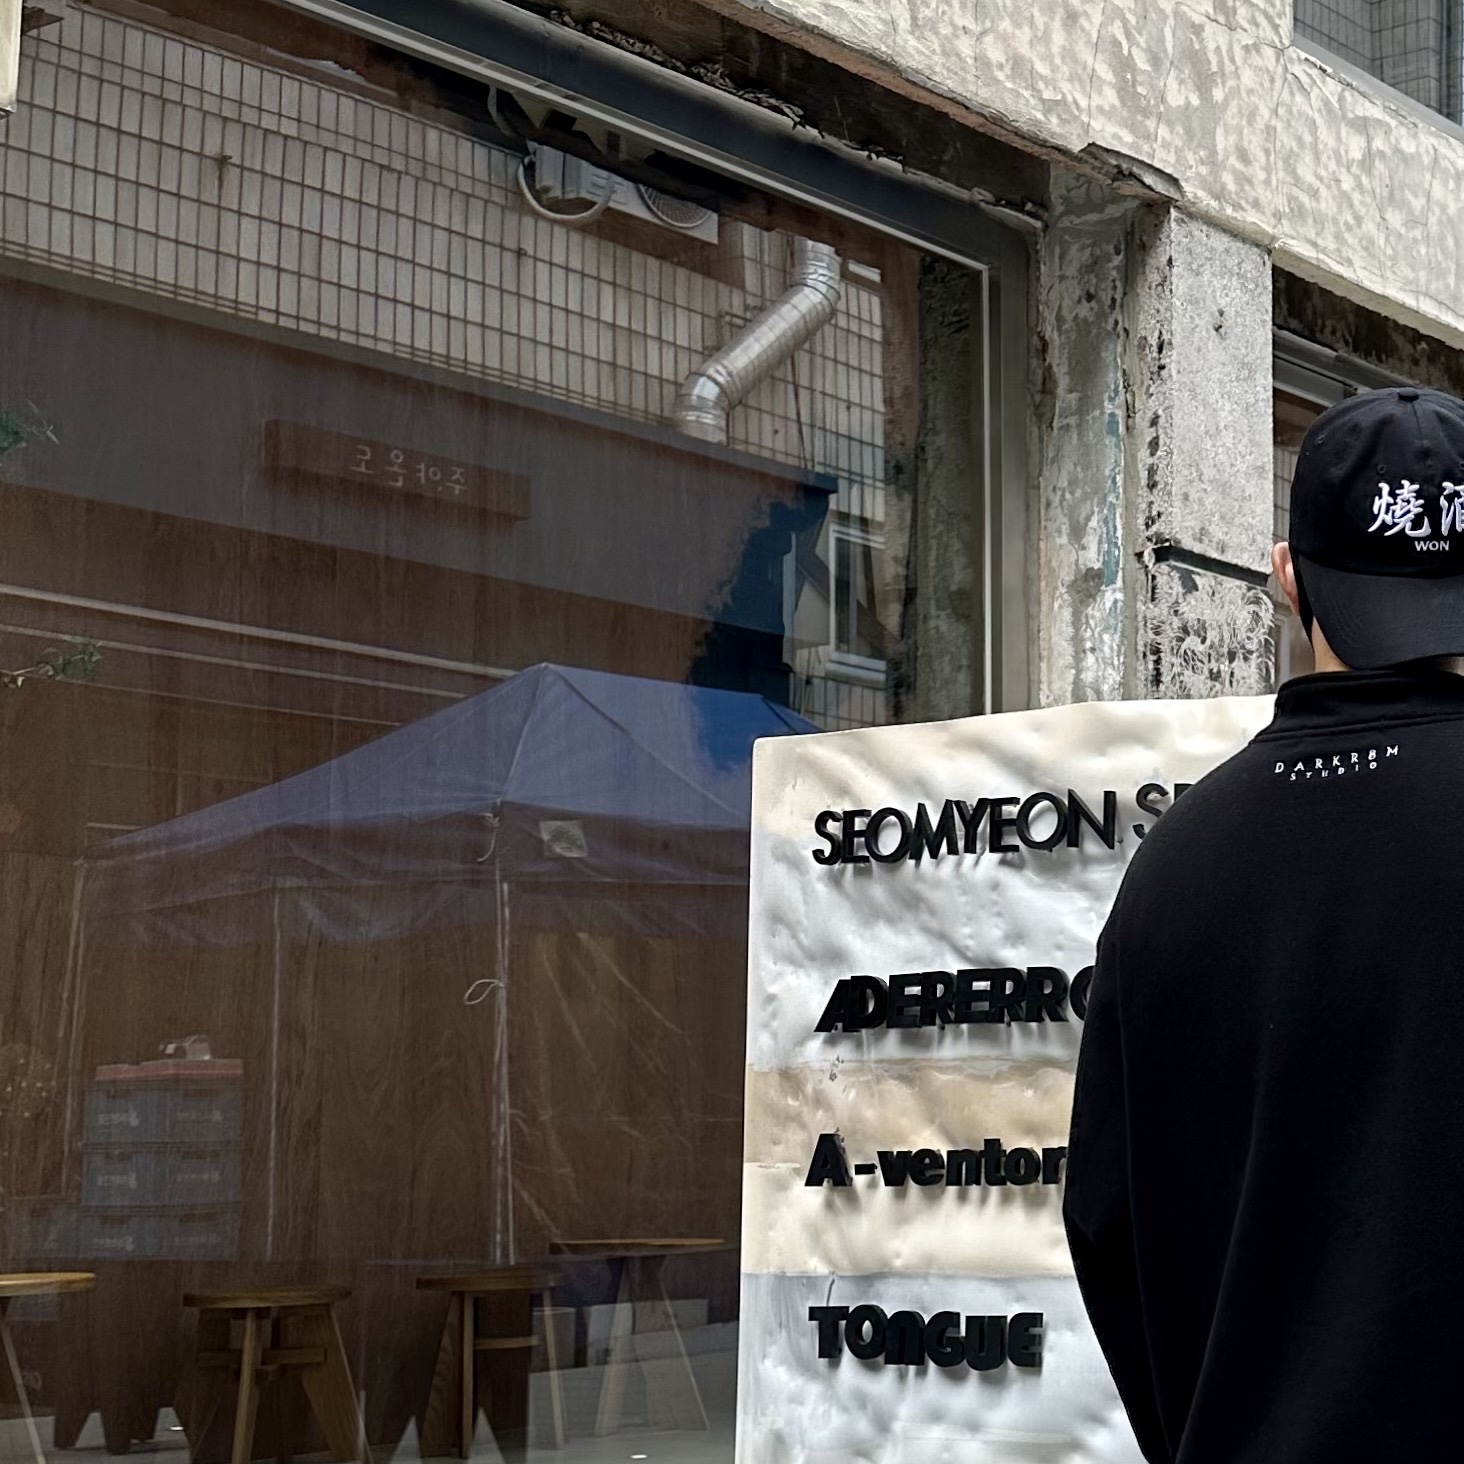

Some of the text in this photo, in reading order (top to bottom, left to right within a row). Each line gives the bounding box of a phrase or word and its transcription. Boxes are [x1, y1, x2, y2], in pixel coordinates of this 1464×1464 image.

[1414, 539, 1450, 552] WON
[1290, 760, 1378, 782] STUDIO
[812, 783, 1195, 867] SEOMYEON S
[808, 1304, 1043, 1371] TONGUE
